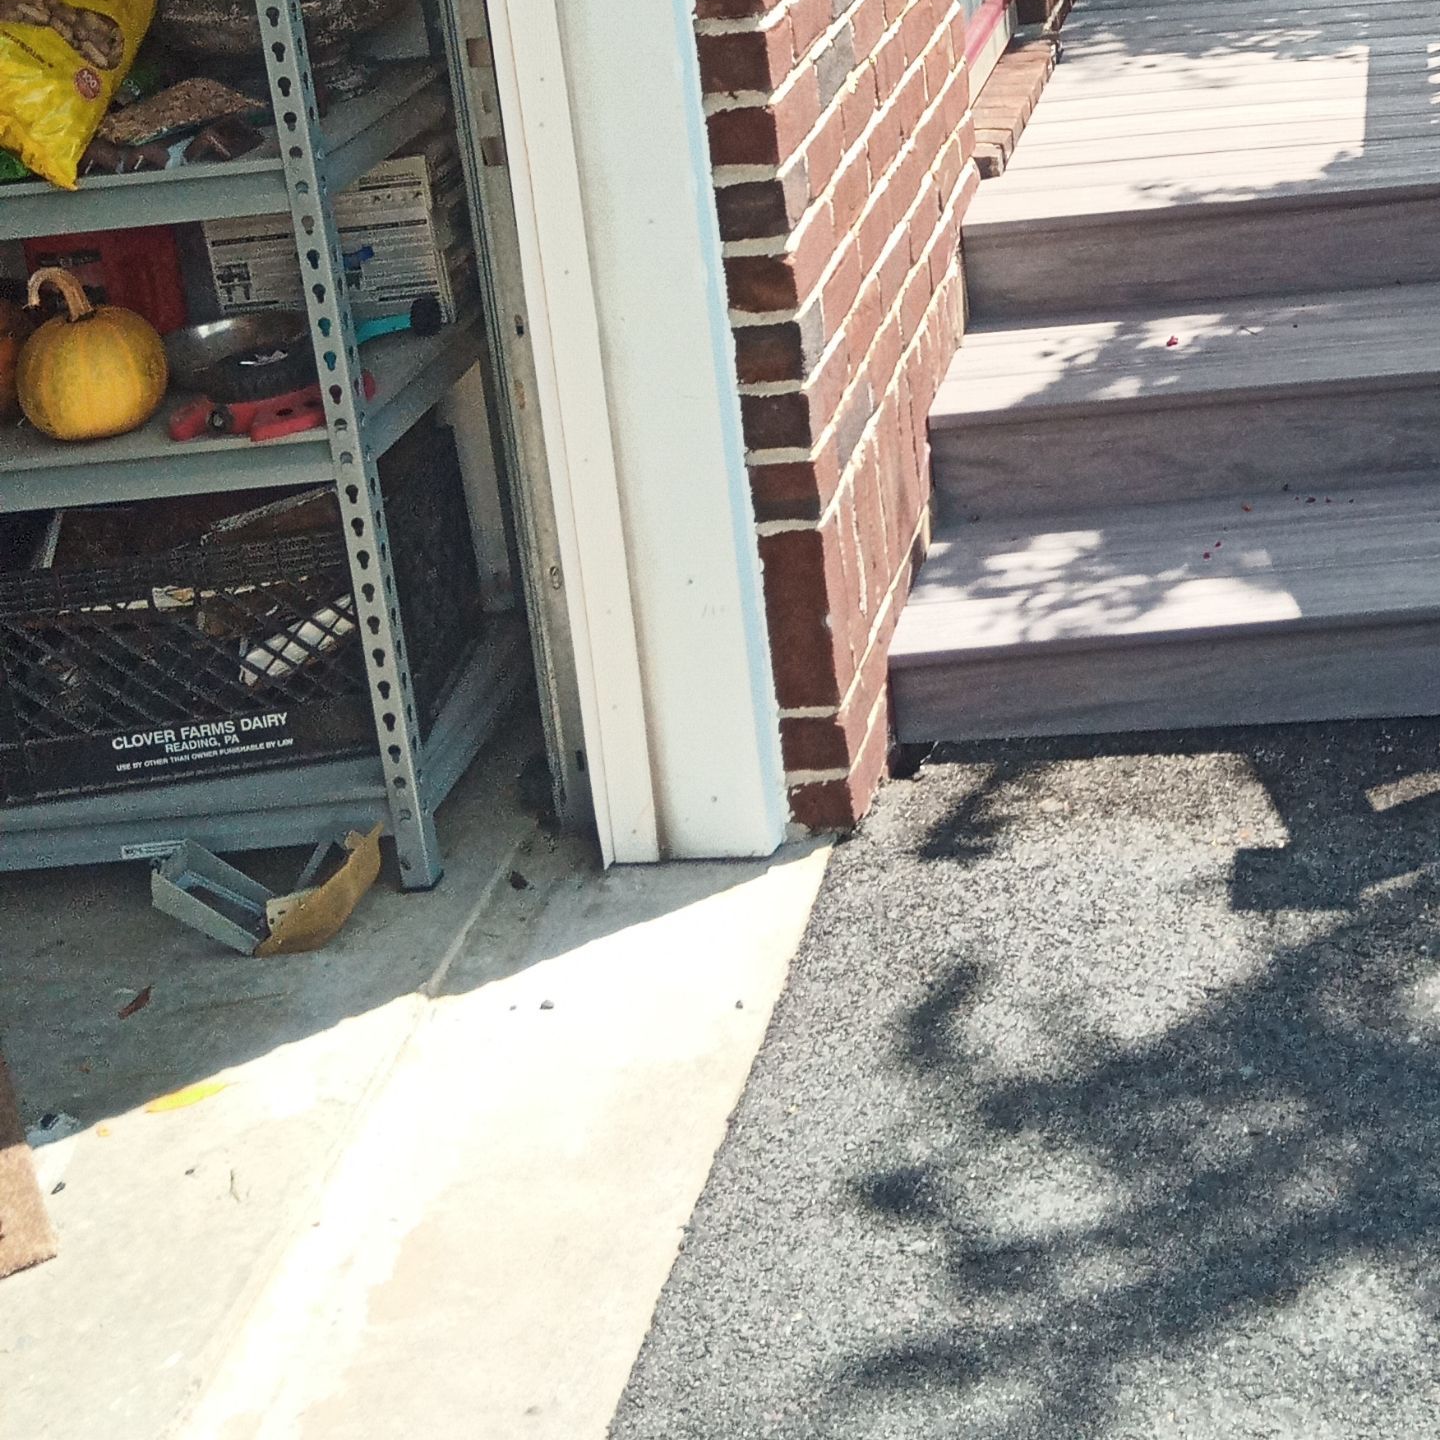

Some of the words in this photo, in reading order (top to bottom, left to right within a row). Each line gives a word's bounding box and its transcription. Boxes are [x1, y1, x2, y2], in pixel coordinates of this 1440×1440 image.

[112, 729, 176, 750] CLOVER
[180, 720, 236, 740] FARMS
[240, 712, 288, 731] DAIRY
[164, 737, 221, 753] READING,
[223, 733, 240, 744] PA
[116, 762, 131, 772] USE
[132, 761, 143, 769] BY
[143, 757, 169, 767] OTHER
[169, 754, 190, 763] THAN
[191, 750, 218, 759] OWNER
[265, 740, 276, 749] BY
[276, 737, 294, 748] LAW
